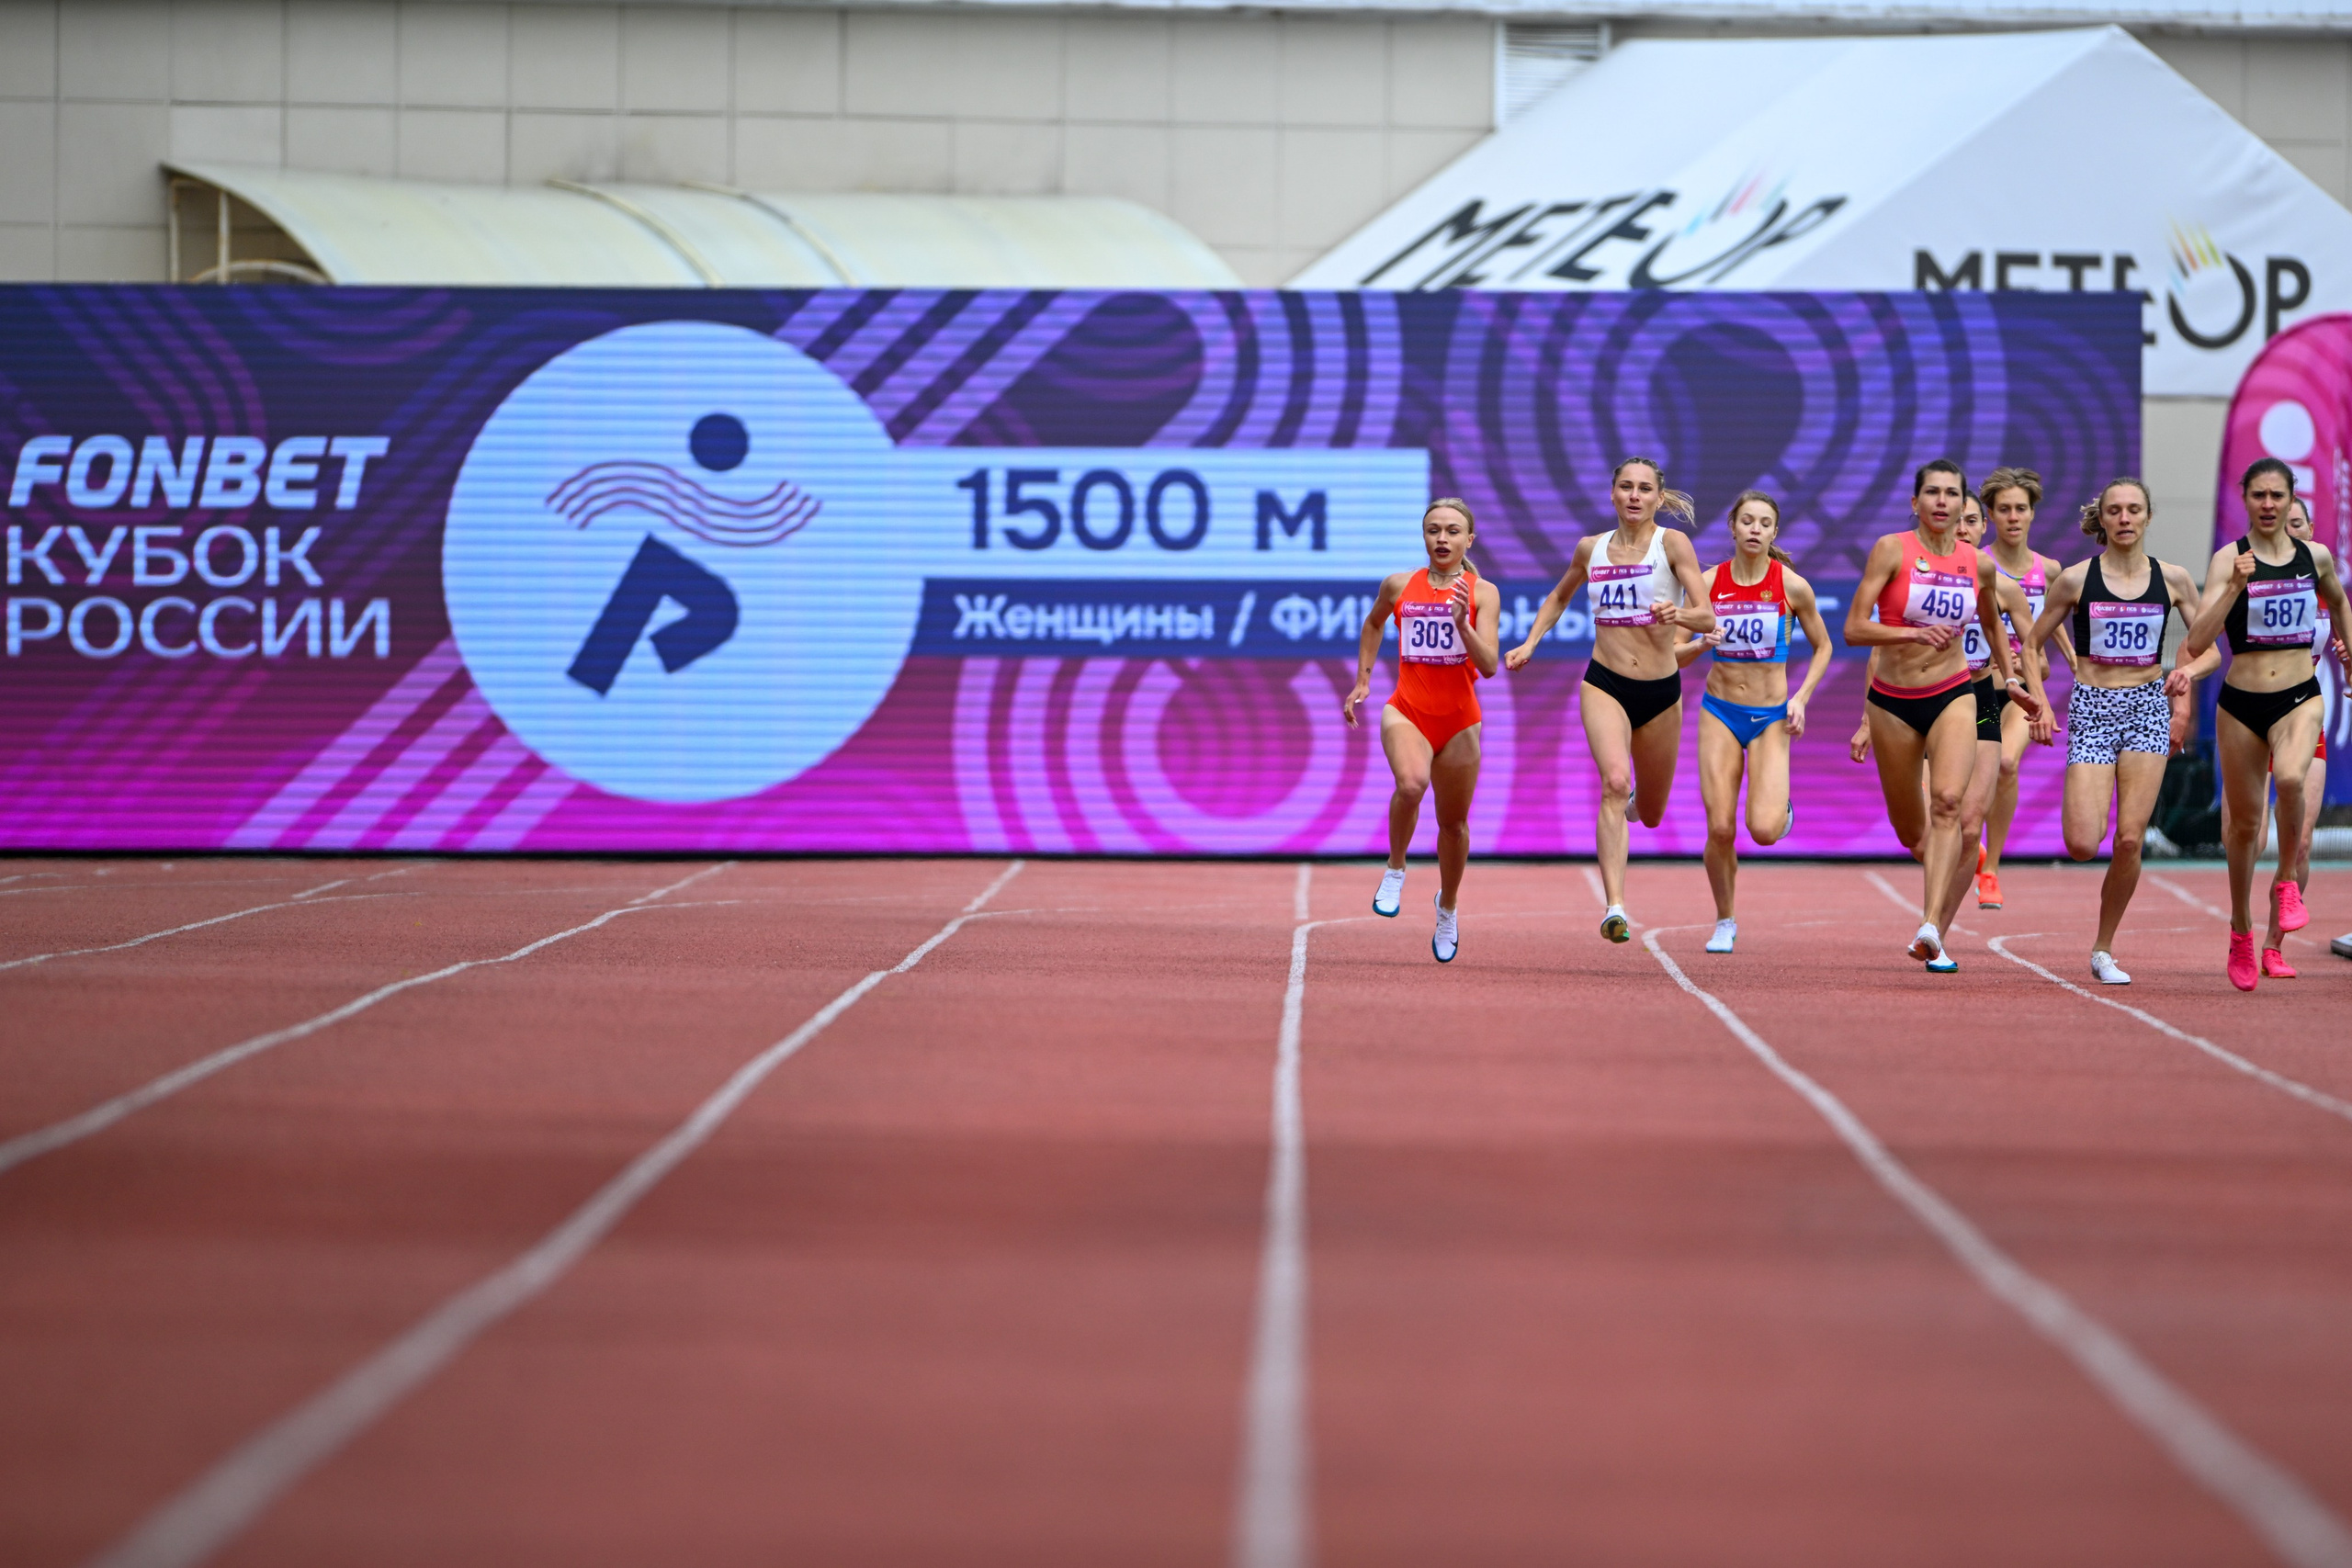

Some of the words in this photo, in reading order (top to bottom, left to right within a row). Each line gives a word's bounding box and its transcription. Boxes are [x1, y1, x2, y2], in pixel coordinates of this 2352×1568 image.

[7, 434, 391, 509] FONBET
[956, 468, 1211, 551] 1500
[6, 525, 324, 587] КУБОК
[1600, 583, 1638, 610] 441
[1921, 589, 1964, 620] 459
[6, 595, 391, 659] РОССИИ
[953, 593, 1216, 645] Женщины
[2264, 598, 2306, 627] 587
[1411, 619, 1454, 649] 303
[1723, 617, 1764, 644] 248
[2104, 621, 2149, 650] 358
